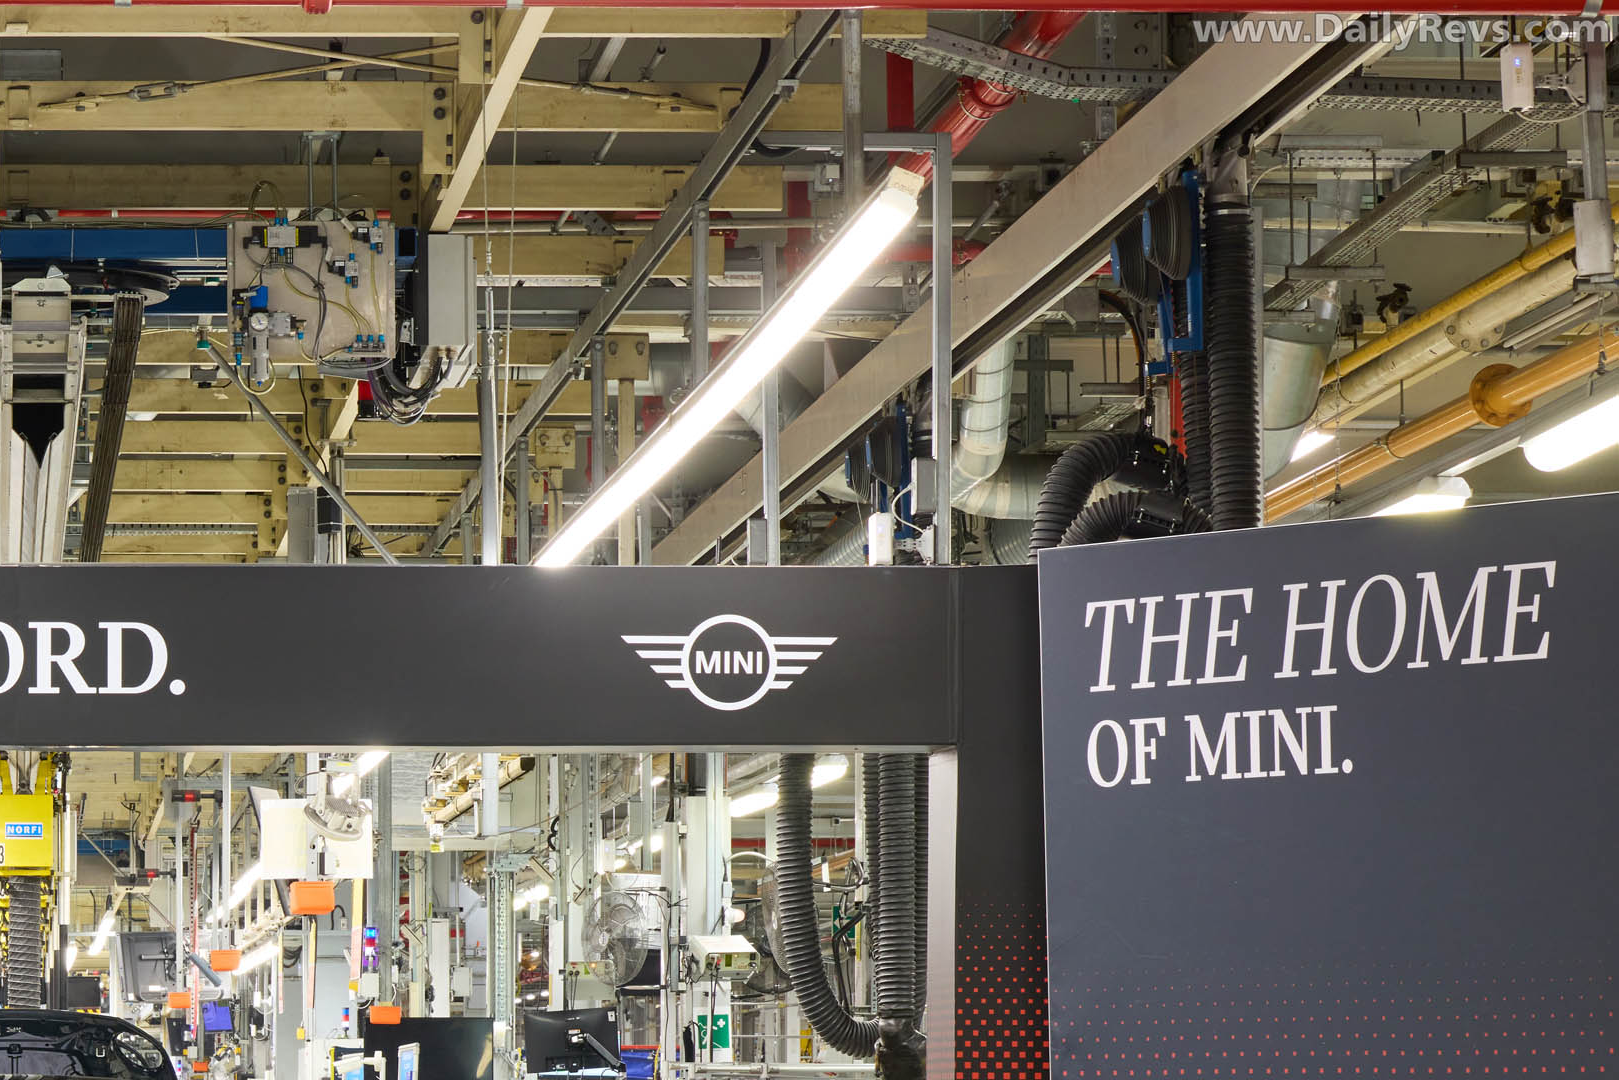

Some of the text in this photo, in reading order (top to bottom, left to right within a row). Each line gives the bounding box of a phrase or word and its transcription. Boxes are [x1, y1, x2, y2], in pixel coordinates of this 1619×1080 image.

[1084, 560, 1557, 693] THE HOME
[695, 650, 763, 675] MINI
[1087, 705, 1353, 788] OF MINI.
[7, 825, 42, 834] NORFI
